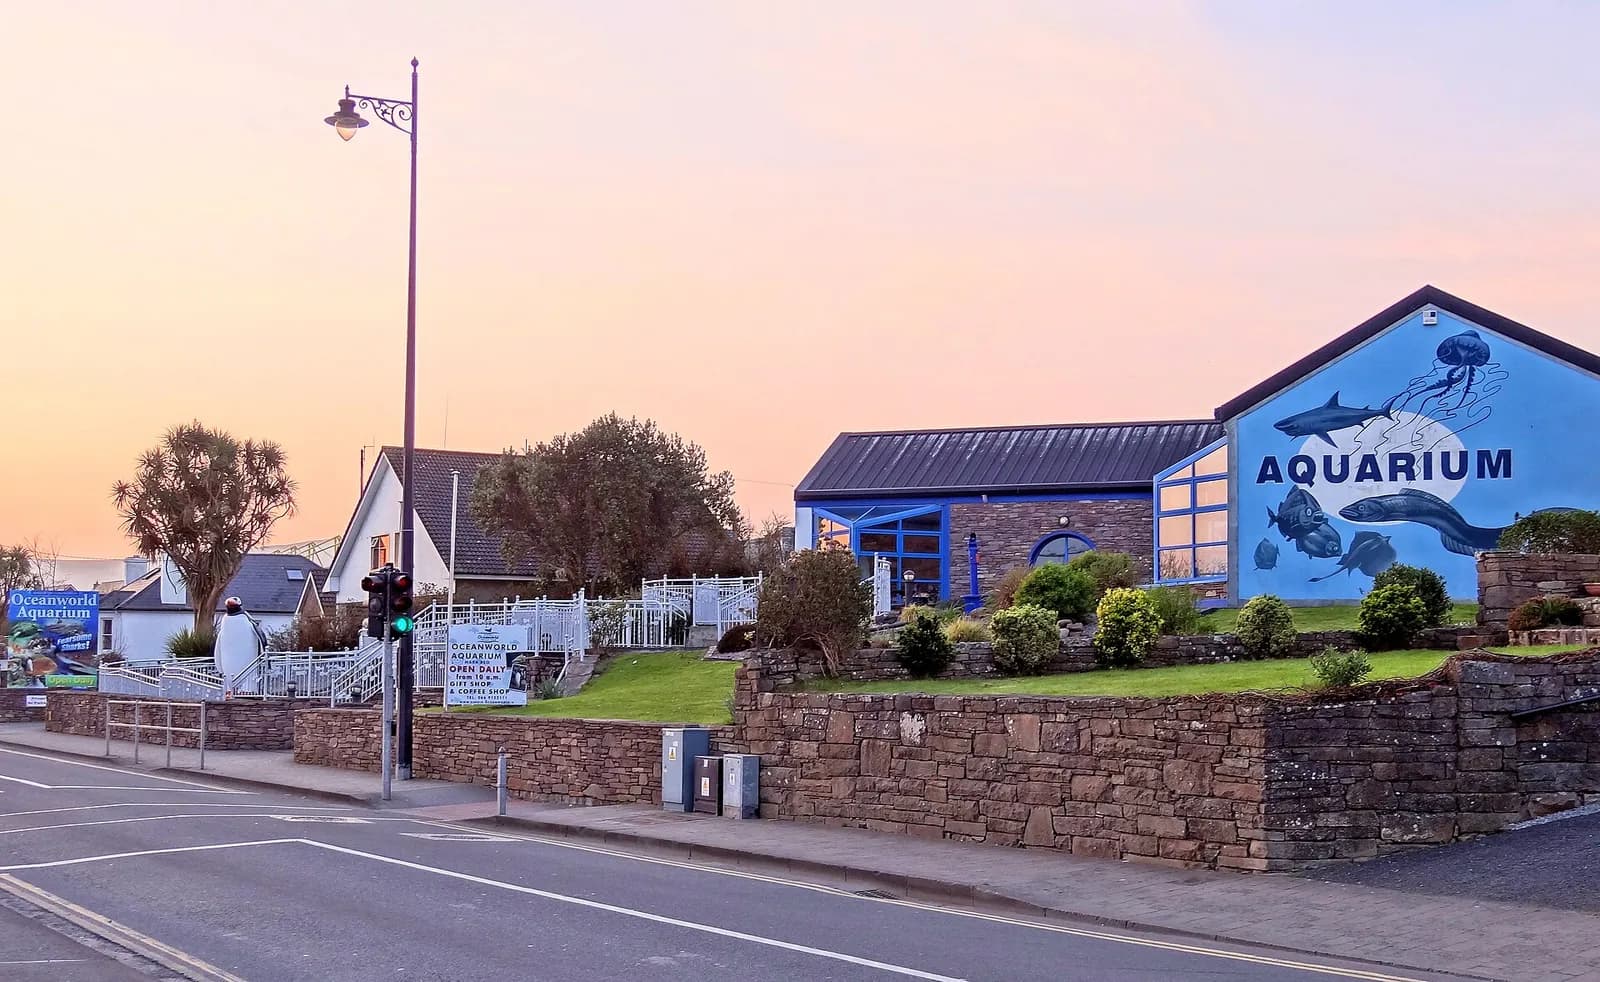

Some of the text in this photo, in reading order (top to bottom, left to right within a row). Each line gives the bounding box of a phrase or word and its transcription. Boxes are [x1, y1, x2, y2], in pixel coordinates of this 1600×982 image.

[1256, 449, 1512, 488] AQUARIUM
[11, 593, 97, 606] Oceanworld
[16, 606, 91, 621] Aquarium
[451, 643, 518, 651] OCEANWORLD
[451, 652, 502, 660] AQUARIUM
[449, 665, 506, 673] OPEN DAILY
[49, 676, 72, 685] Open
